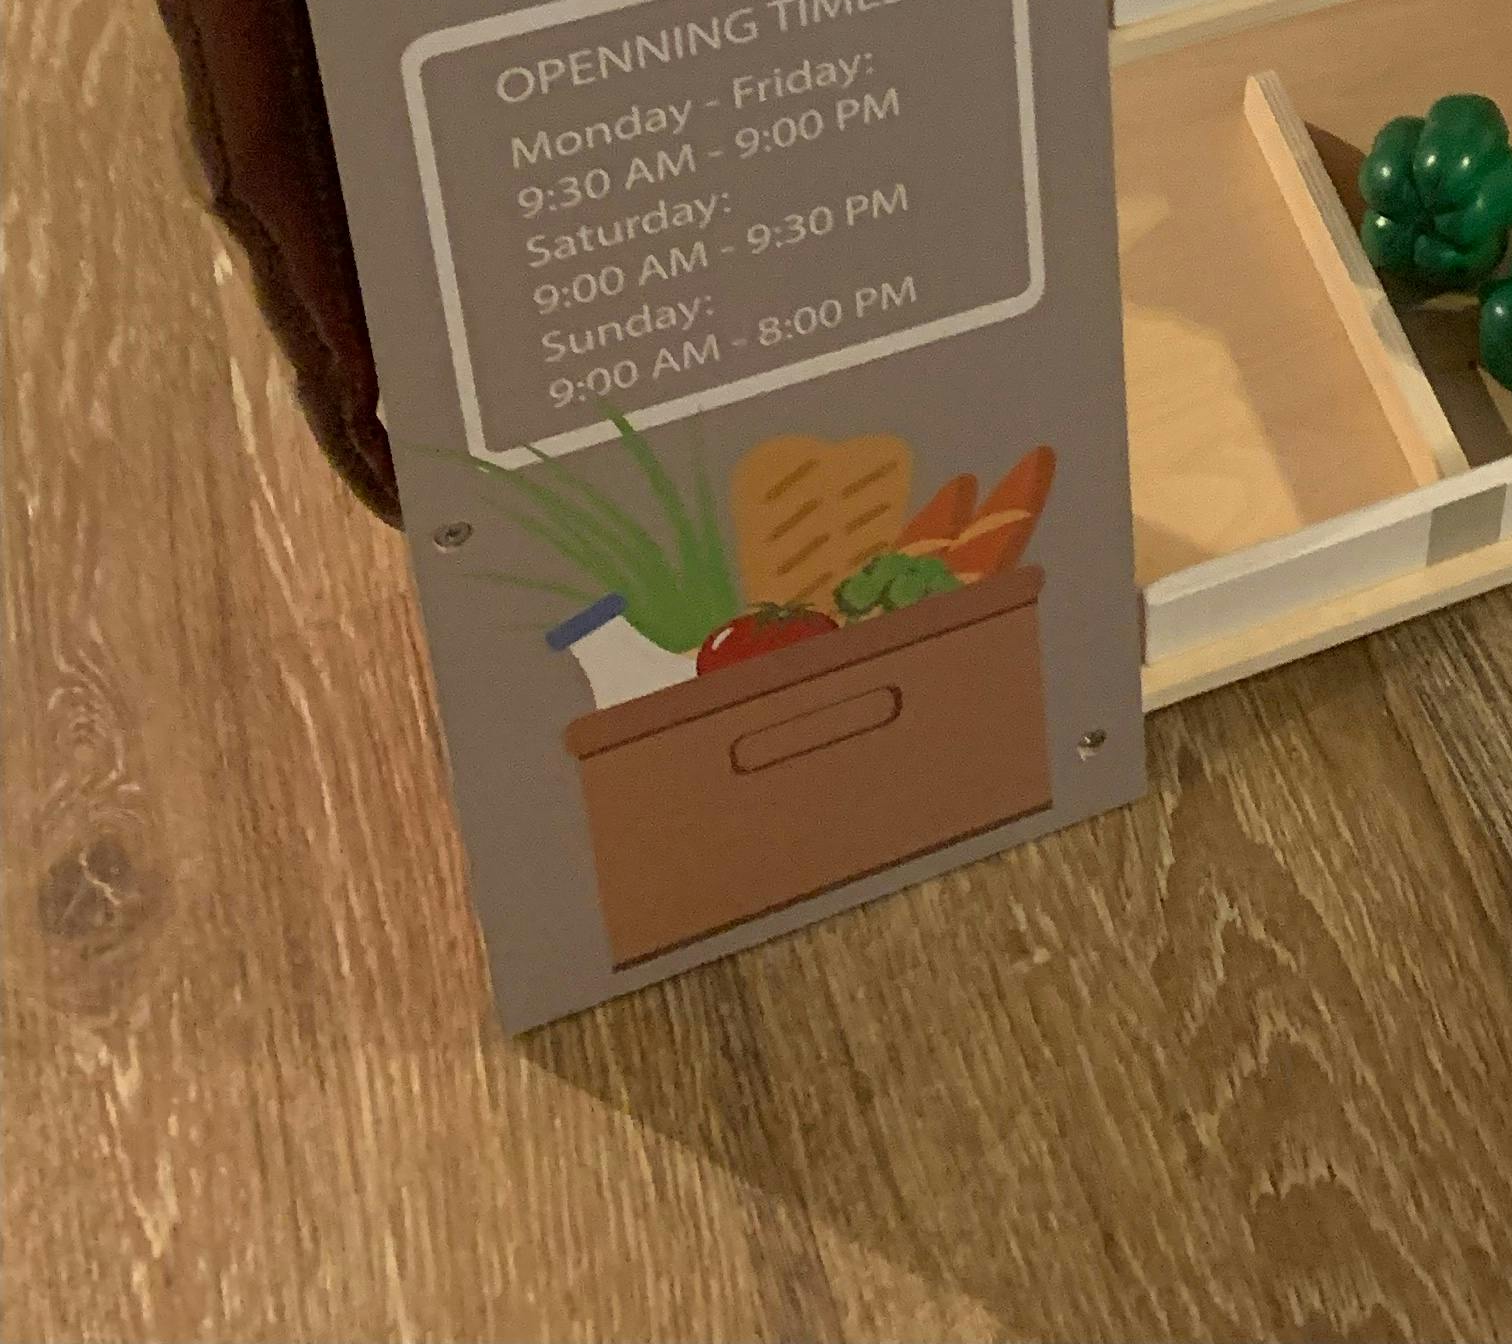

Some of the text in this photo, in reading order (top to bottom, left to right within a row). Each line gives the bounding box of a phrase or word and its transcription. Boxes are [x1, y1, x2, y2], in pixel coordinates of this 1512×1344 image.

[497, 8, 760, 103] OPENNING
[511, 99, 692, 168] Monday
[733, 52, 874, 109] Friday:
[517, 168, 611, 219] 9:30
[624, 143, 697, 191] AM
[735, 109, 824, 159] 9:00
[836, 87, 901, 131] PM
[526, 192, 731, 268] Saturday:
[533, 266, 625, 315] 9:00
[638, 241, 709, 287] AM
[747, 205, 835, 255] 9:30
[845, 183, 909, 226] PM
[541, 295, 715, 363] Sunday:
[549, 359, 640, 409] 9:00
[652, 334, 721, 380] AM
[758, 299, 844, 346] 8:00
[855, 276, 918, 318] PM
